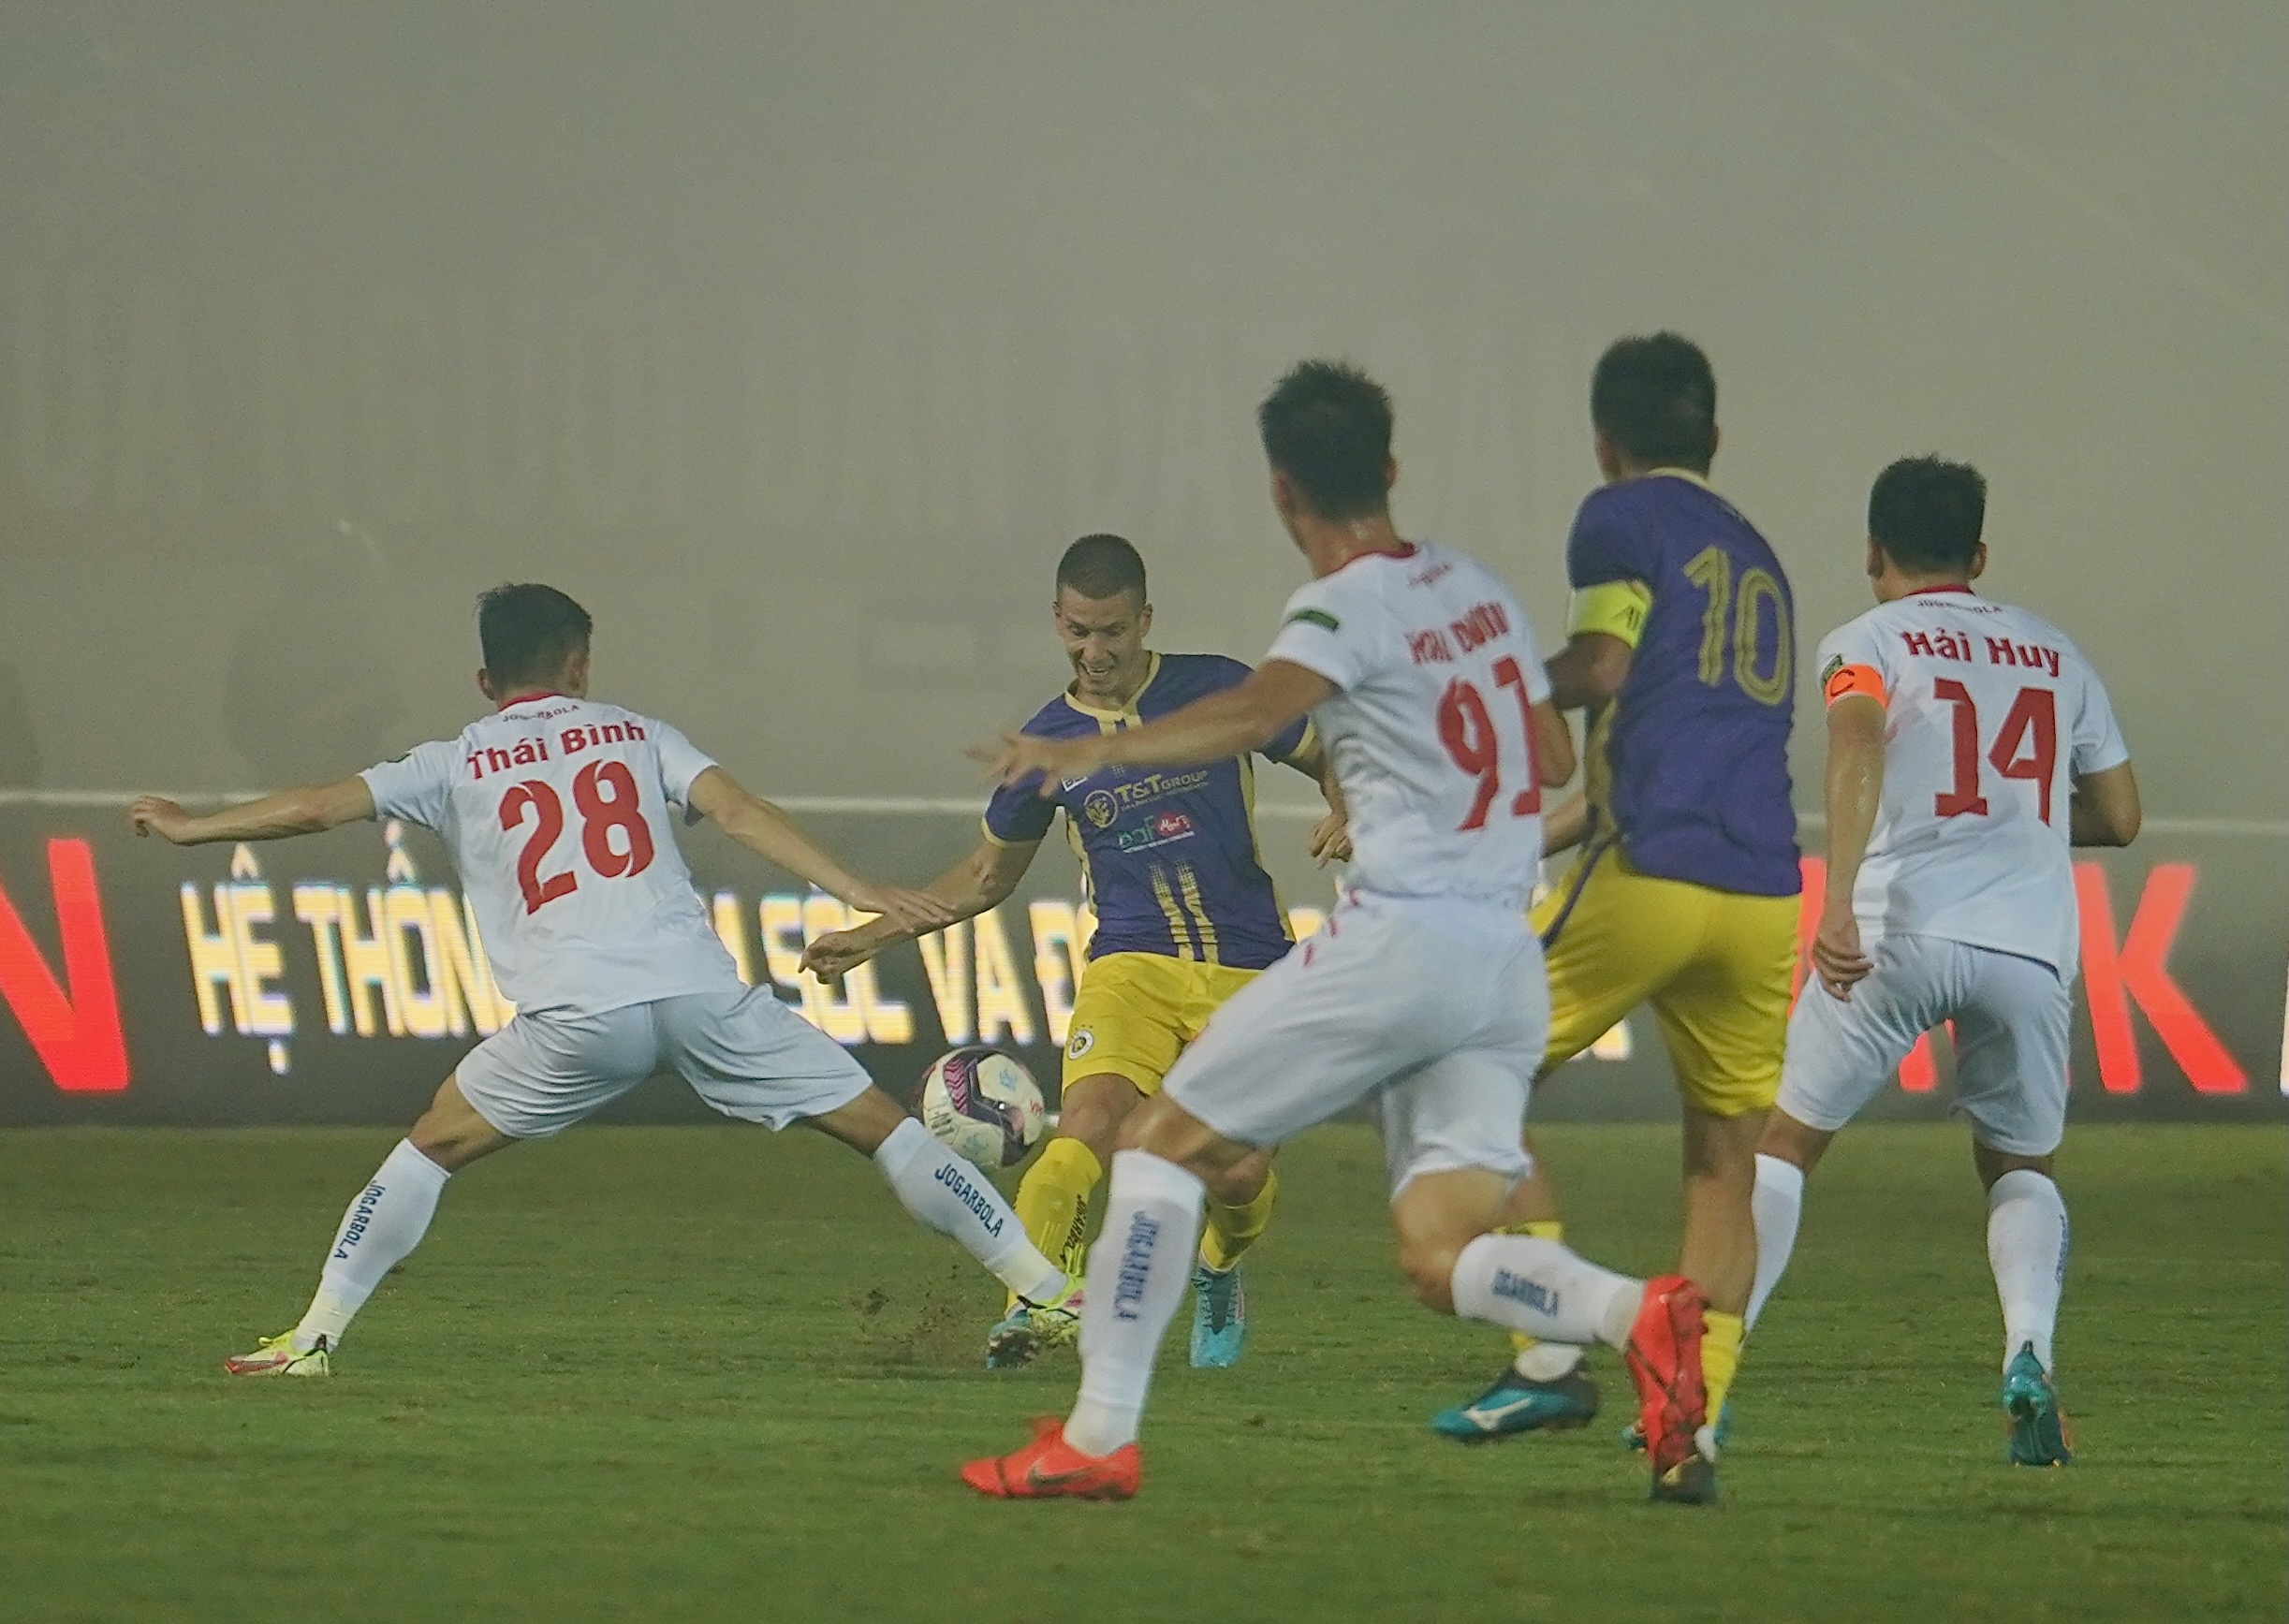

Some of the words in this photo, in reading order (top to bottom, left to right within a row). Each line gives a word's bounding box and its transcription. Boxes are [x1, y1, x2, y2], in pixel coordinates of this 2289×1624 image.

[1685, 545, 1792, 706] 10
[1900, 626, 1972, 664] Hải
[1983, 635, 2059, 679] Huy
[467, 737, 550, 779] Thái
[560, 720, 645, 755] Bình
[1934, 676, 2058, 827] 14
[499, 758, 654, 915] 28
[292, 822, 516, 1039] THỐN
[333, 1179, 387, 1259] JOGARBOLA
[933, 1163, 1005, 1238] JOGARBOLA
